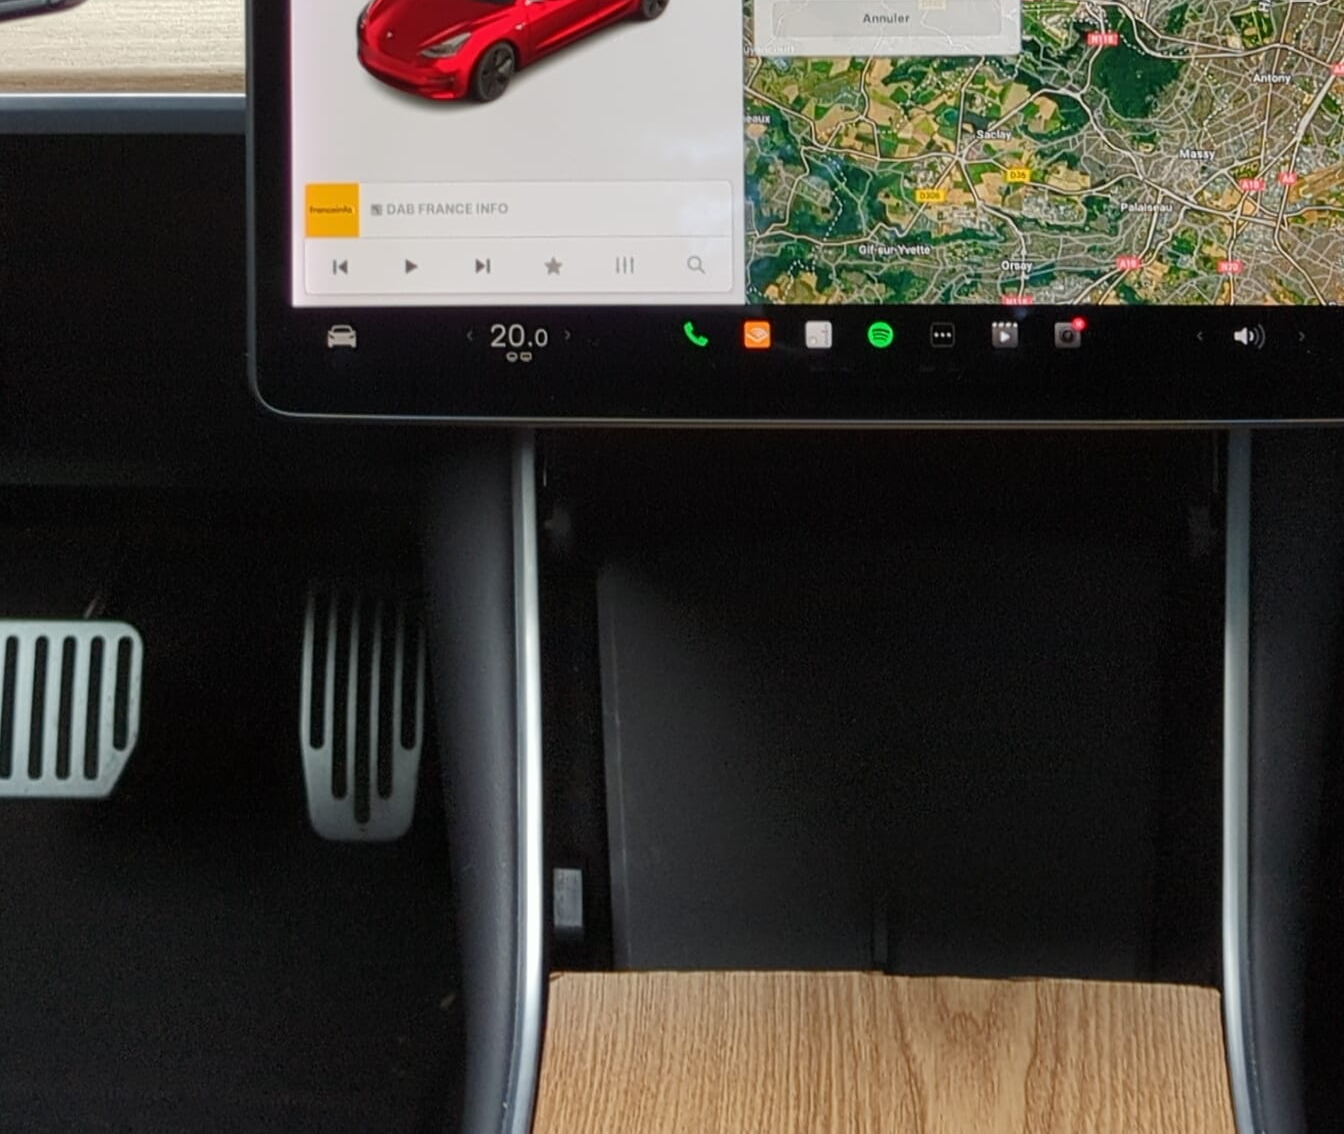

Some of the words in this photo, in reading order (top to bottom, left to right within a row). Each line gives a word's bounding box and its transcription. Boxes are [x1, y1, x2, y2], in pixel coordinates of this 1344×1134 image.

[862, 13, 911, 25] Annuler
[1253, 73, 1292, 85] Antony
[976, 129, 1012, 142] Saclay
[1179, 148, 1216, 161] Massy
[386, 203, 415, 215] DAB
[418, 203, 473, 215] FRANCE
[475, 203, 509, 215] INFO
[1120, 202, 1174, 212] Palaiseau
[859, 244, 931, 256] Gif-sur-Yvette
[1001, 260, 1033, 273] Orsay
[490, 323, 549, 348] 20.0
